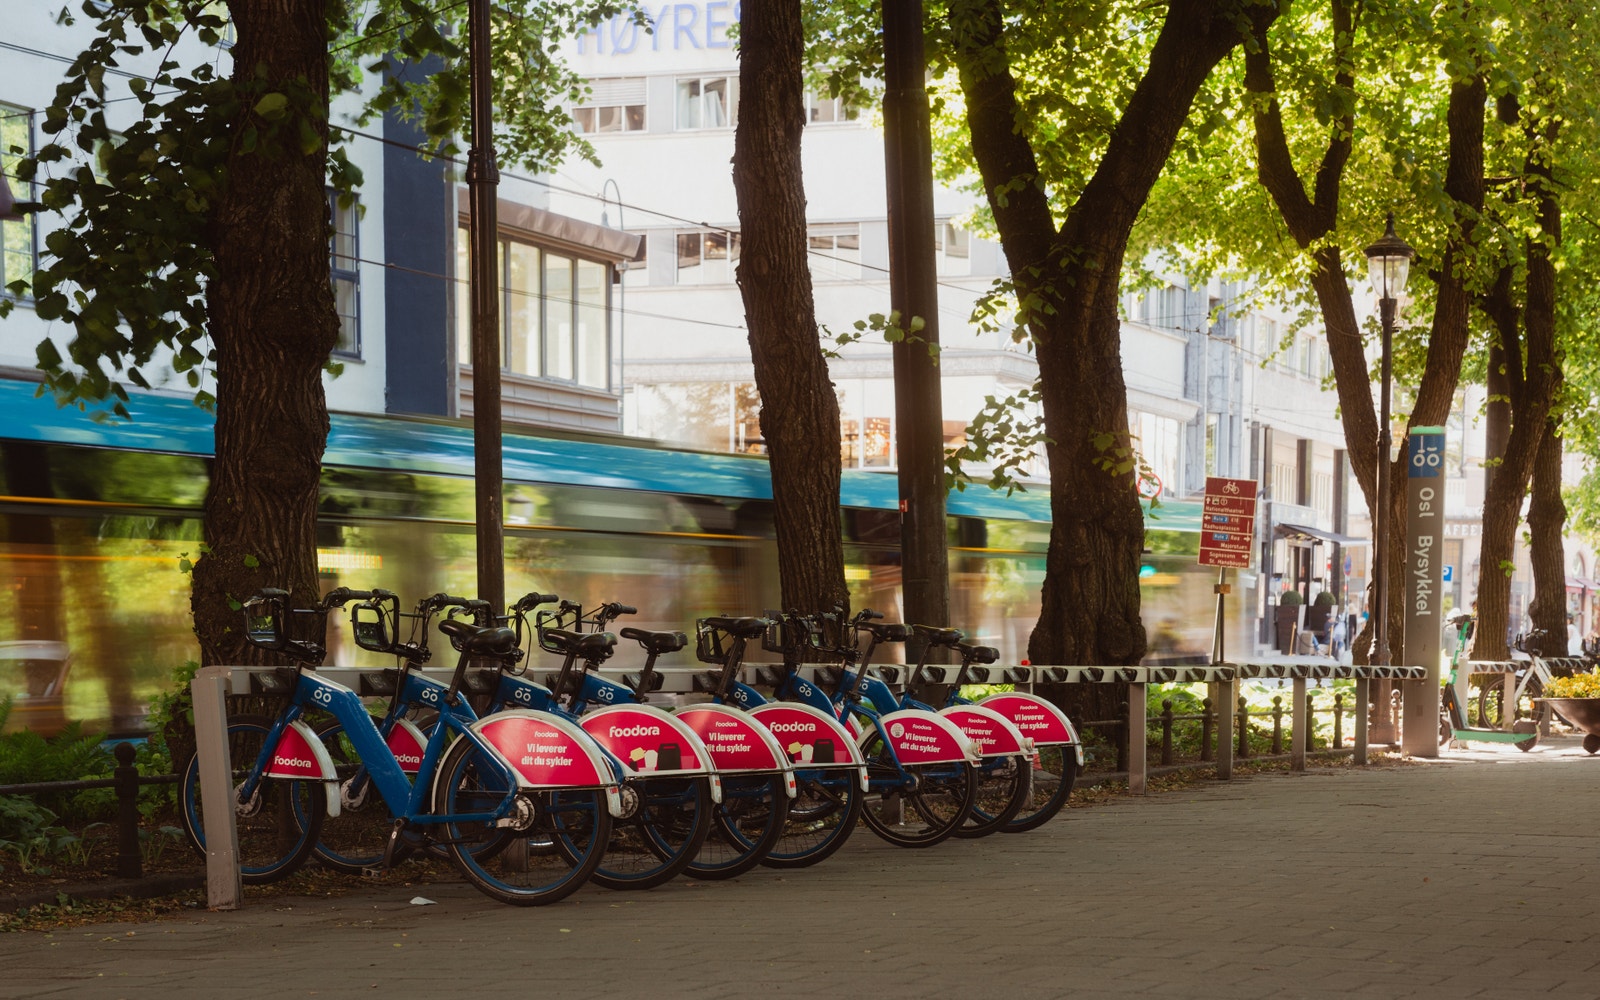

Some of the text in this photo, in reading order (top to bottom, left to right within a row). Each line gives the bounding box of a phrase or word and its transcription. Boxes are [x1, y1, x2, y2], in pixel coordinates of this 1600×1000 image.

[1206, 506, 1244, 514] Nationaltheatret
[1444, 524, 1482, 536] AFEE
[1414, 487, 1434, 616] Osl Bysykkel
[770, 721, 816, 732] foodora
[609, 725, 660, 738] foodora
[709, 732, 746, 741] Vi leverer
[912, 733, 937, 742] leverer
[527, 744, 567, 753] Vi leverer
[727, 744, 751, 753] sykler
[920, 745, 941, 753] sykler
[274, 755, 312, 768] foodora
[394, 754, 420, 763] odora
[521, 756, 573, 768] dit du sykler
